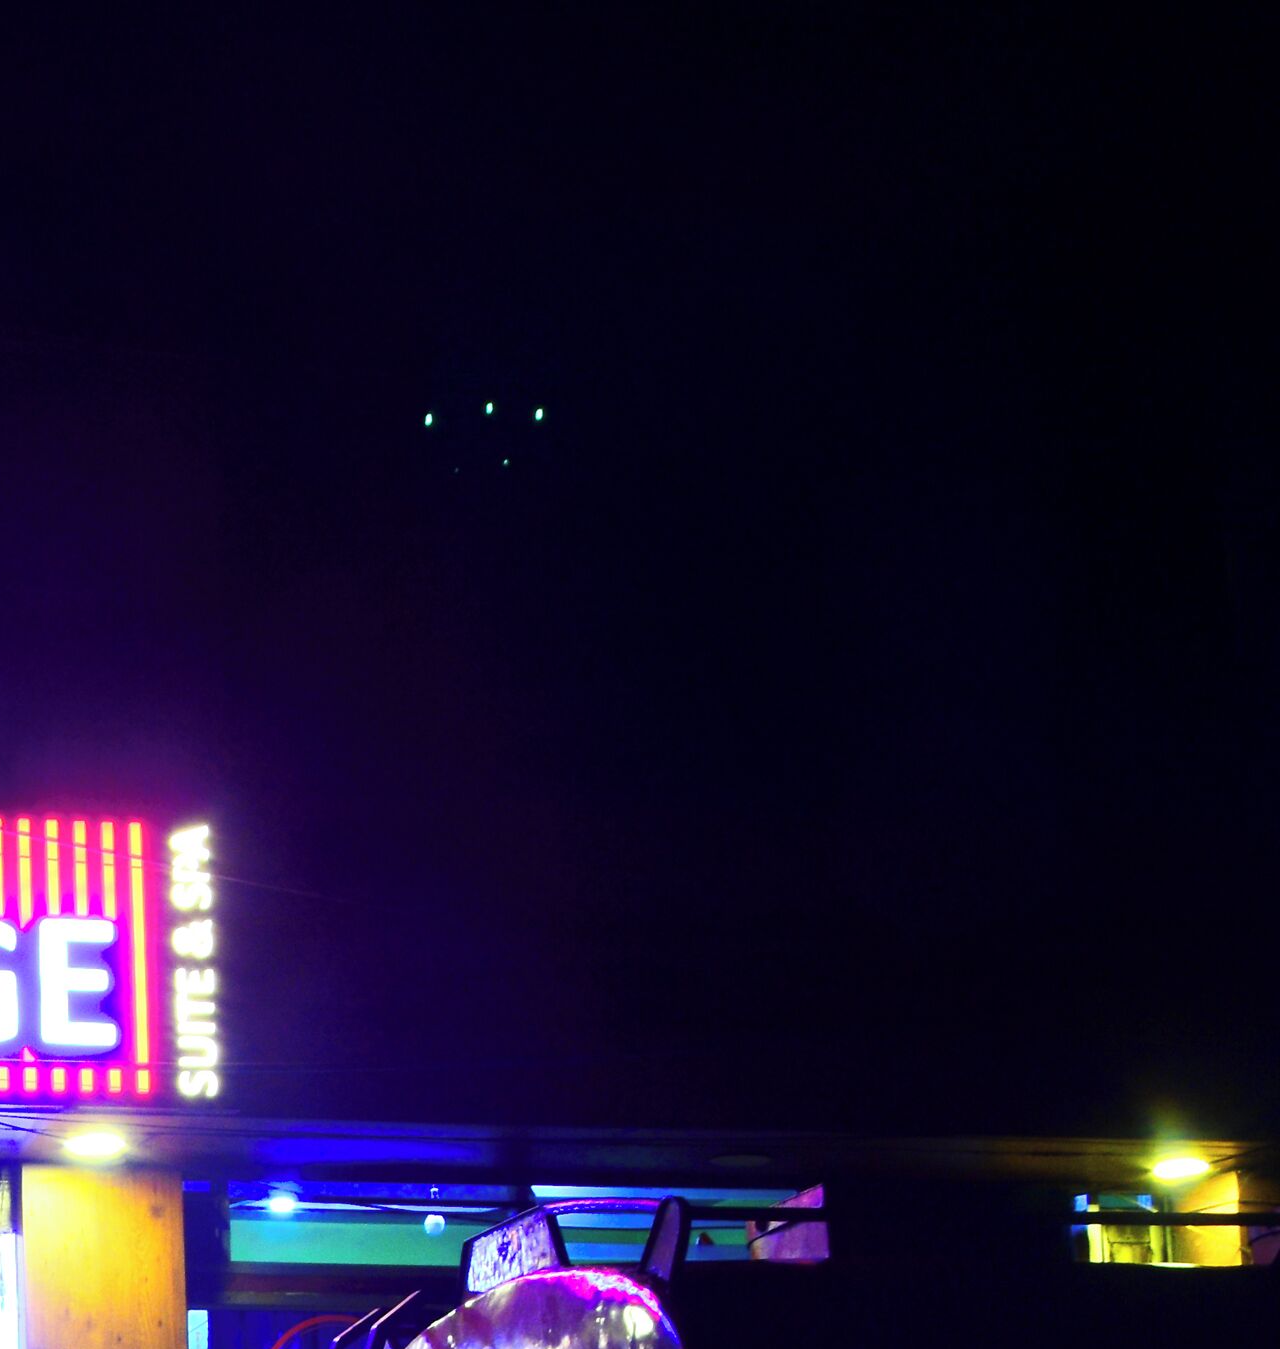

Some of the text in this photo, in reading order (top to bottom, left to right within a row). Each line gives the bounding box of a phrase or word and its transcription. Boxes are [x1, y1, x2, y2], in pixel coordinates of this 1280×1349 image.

[170, 824, 220, 1099] SUITE & SPA
